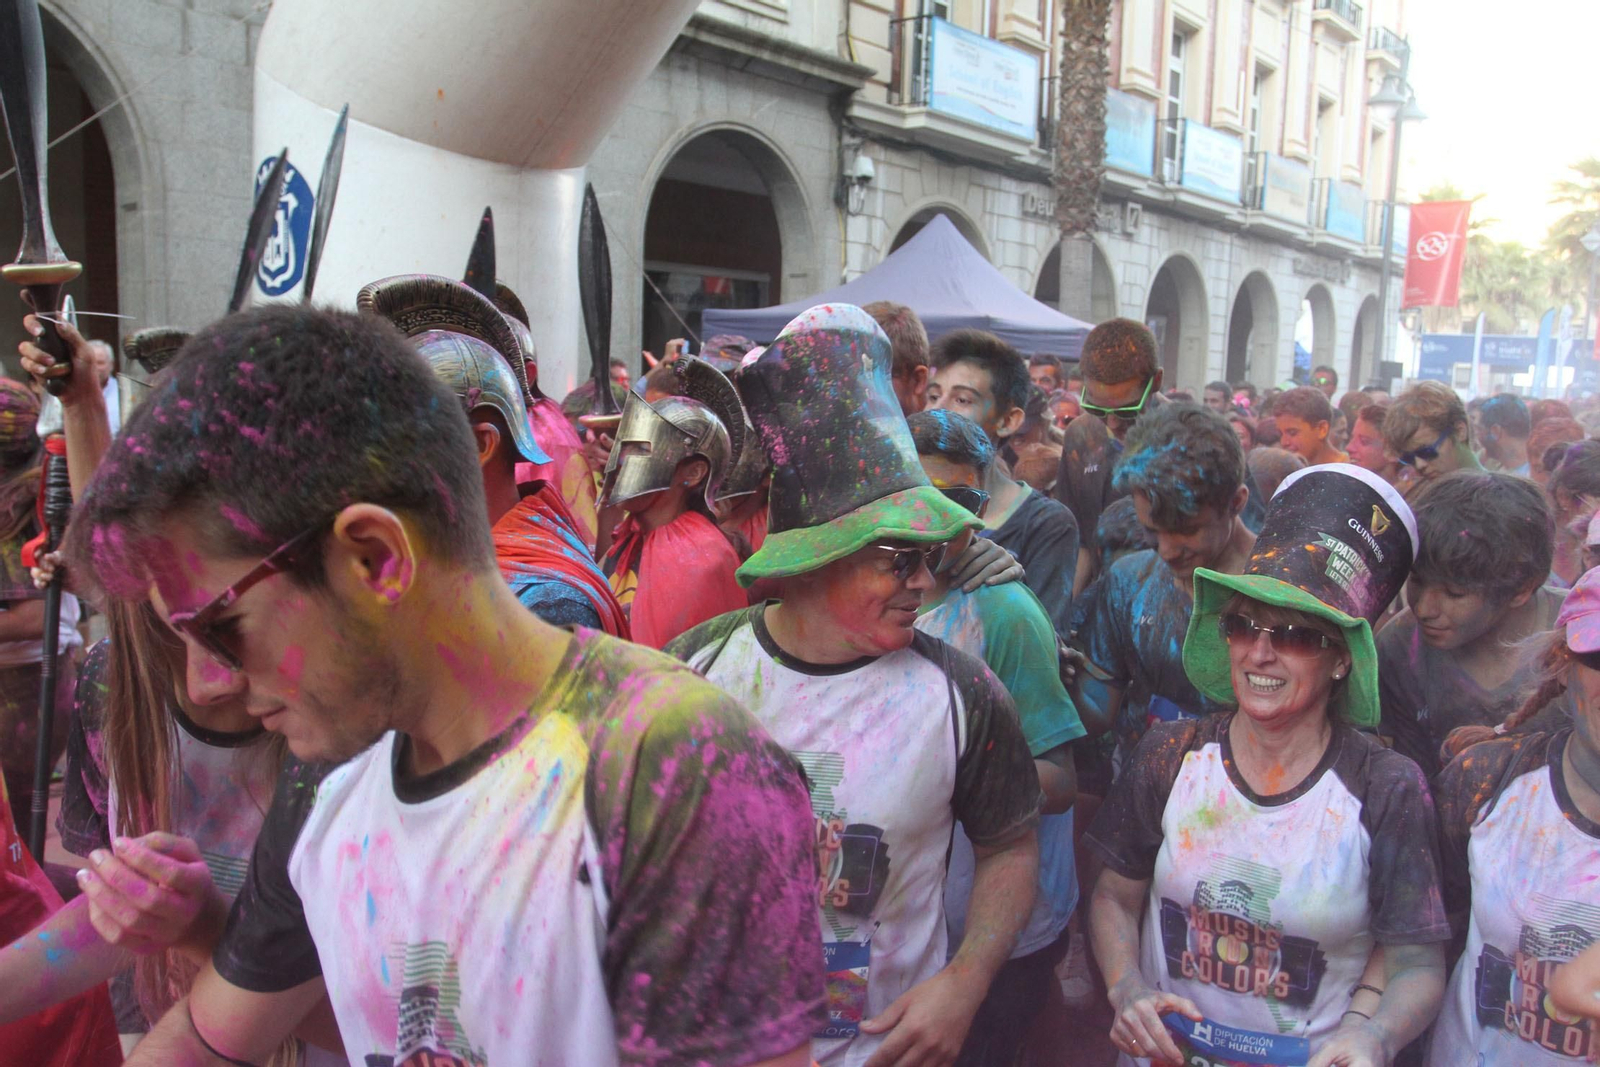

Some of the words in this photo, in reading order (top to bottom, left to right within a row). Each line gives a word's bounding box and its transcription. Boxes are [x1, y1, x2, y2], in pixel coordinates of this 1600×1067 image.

[1325, 538, 1337, 549] ST
[1348, 518, 1385, 564] GUINNESS
[1190, 905, 1282, 950] MUSIC
[1200, 931, 1269, 970] RUN
[1181, 950, 1290, 998] COLORS
[1213, 1037, 1226, 1047] DE
[1228, 1041, 1267, 1057] HUELVA
[1214, 1028, 1274, 1048] DIPUTACIÓN
